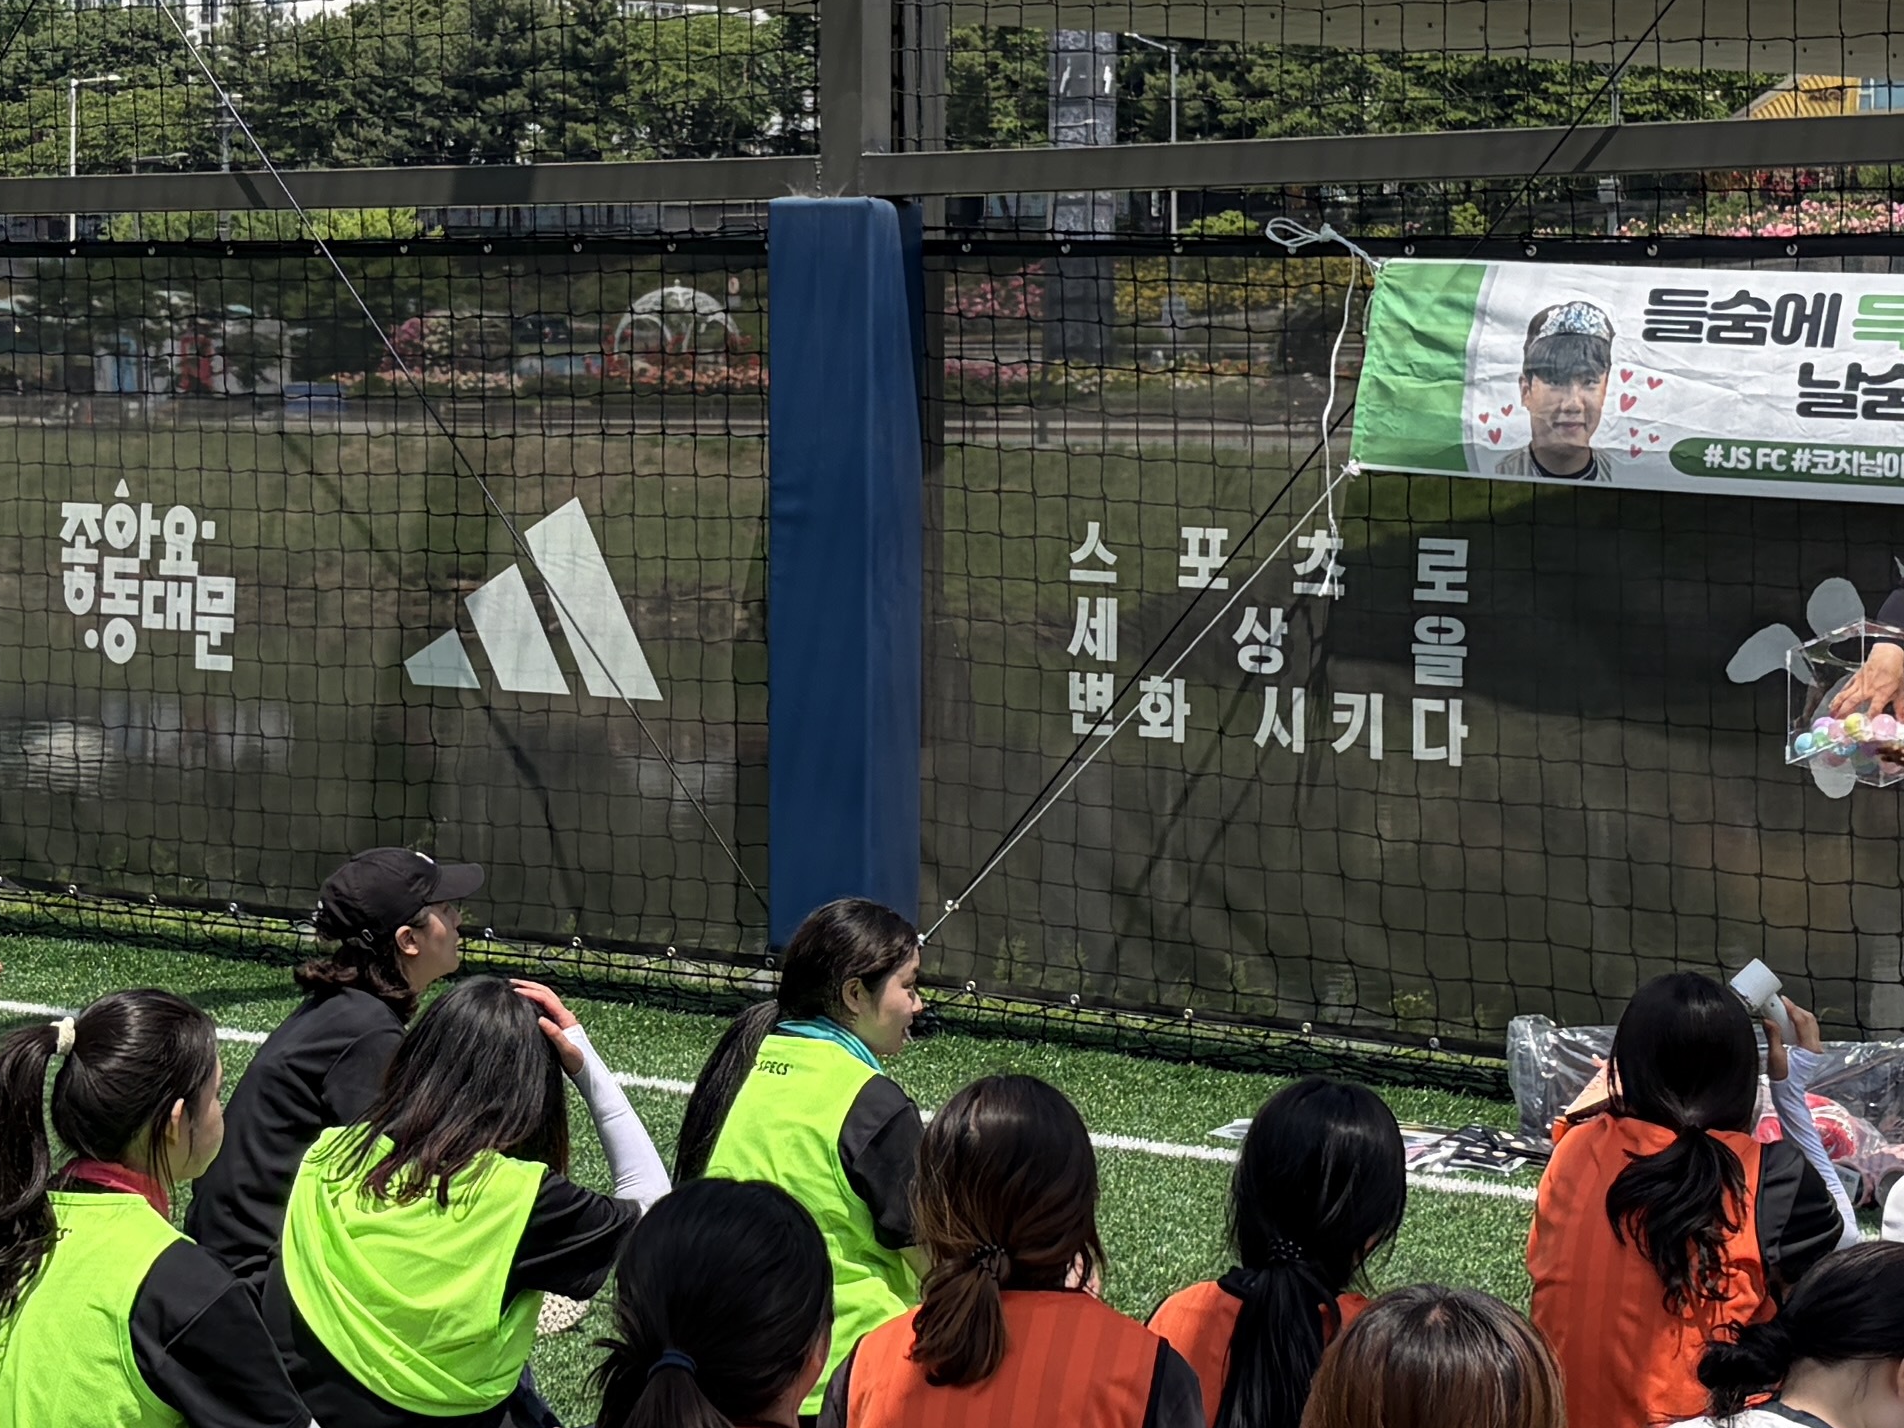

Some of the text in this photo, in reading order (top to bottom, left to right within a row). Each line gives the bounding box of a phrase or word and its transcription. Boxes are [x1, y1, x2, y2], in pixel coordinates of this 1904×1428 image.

[1642, 288, 1843, 348] 들숨에
[1703, 443, 1752, 470] #JS
[1756, 448, 1787, 472] FC
[1069, 521, 1469, 603] 스포츠로
[1067, 597, 1468, 687] 세상을
[1069, 671, 1469, 766] 변화 시키다
